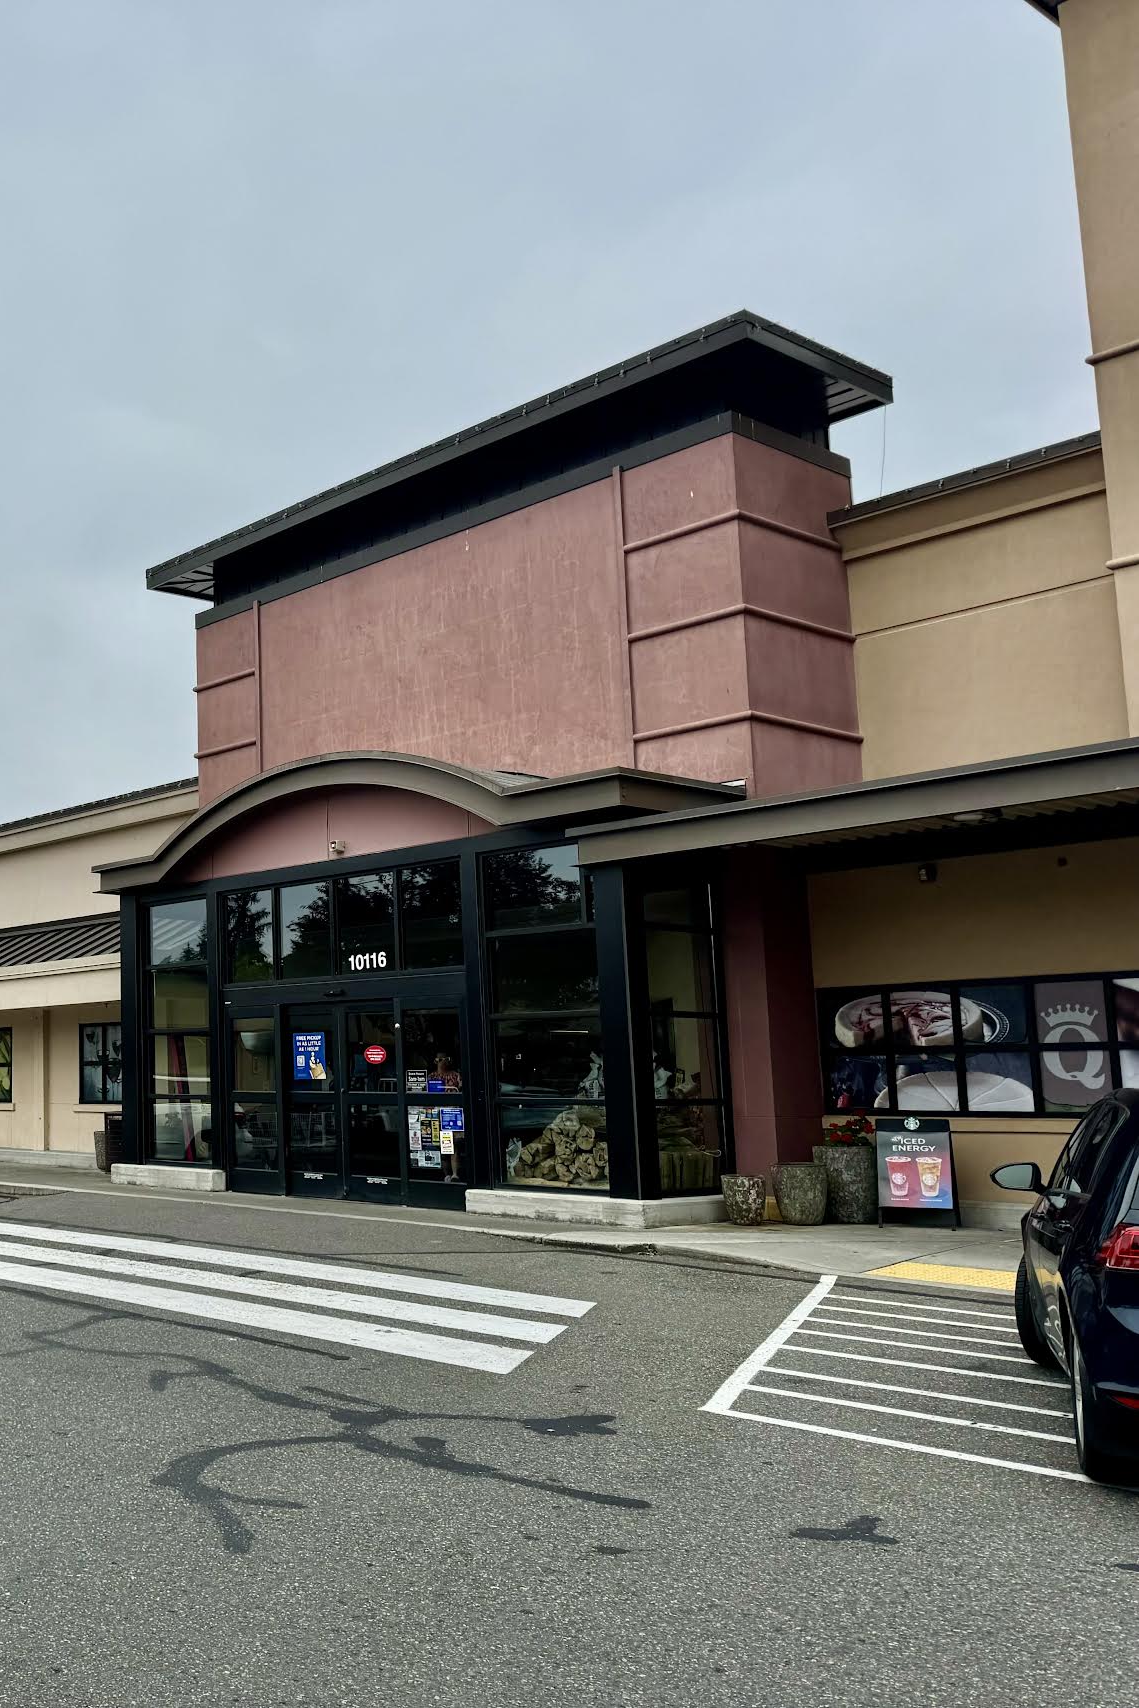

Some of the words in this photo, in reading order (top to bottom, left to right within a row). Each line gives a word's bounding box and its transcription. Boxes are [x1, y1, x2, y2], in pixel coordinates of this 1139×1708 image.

[348, 951, 387, 971] 10116
[1043, 1024, 1105, 1090] Q
[892, 1144, 936, 1152] ENERGY
[900, 1137, 926, 1145] ICED
